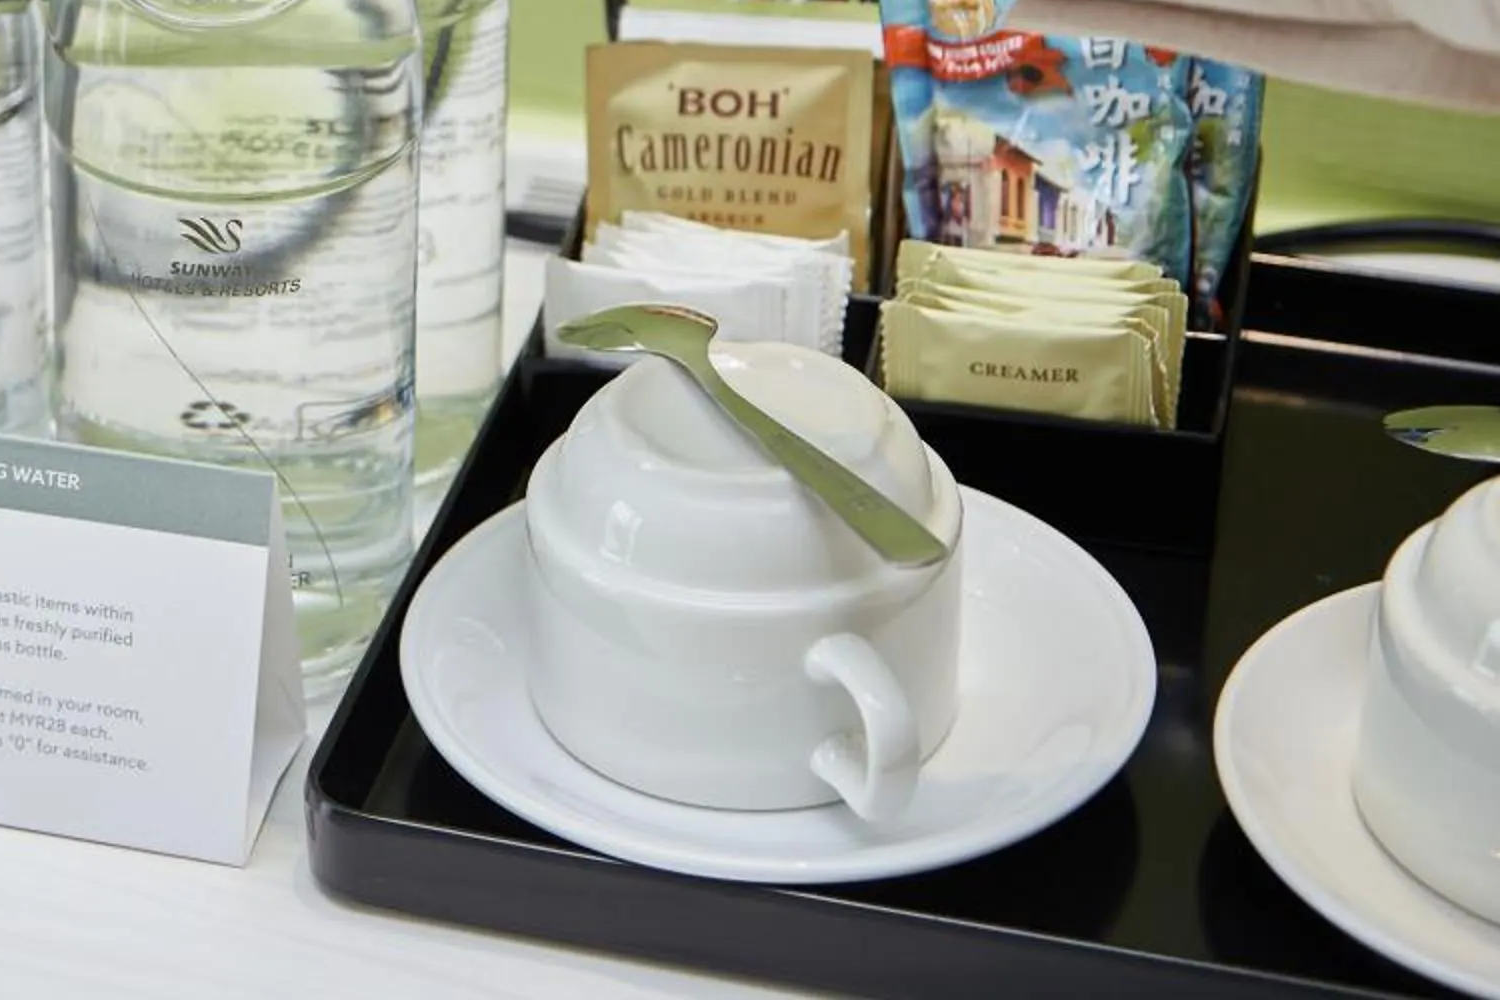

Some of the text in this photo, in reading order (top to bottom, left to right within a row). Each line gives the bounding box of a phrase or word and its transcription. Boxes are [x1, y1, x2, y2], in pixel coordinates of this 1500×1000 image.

[616, 122, 843, 184] Cameronian
[657, 185, 713, 203] GOLD
[219, 278, 301, 298] RESORTS
[968, 360, 1080, 384] CREAMER
[12, 464, 80, 491] WATER
[35, 593, 80, 615] items
[84, 602, 133, 623] within
[14, 615, 67, 642] freshly
[71, 626, 134, 648] purified
[15, 639, 68, 662] bottle.
[37, 690, 52, 708] in
[56, 695, 92, 714] your
[96, 704, 144, 726] room,
[70, 721, 113, 742] each.
[36, 737, 60, 758] for
